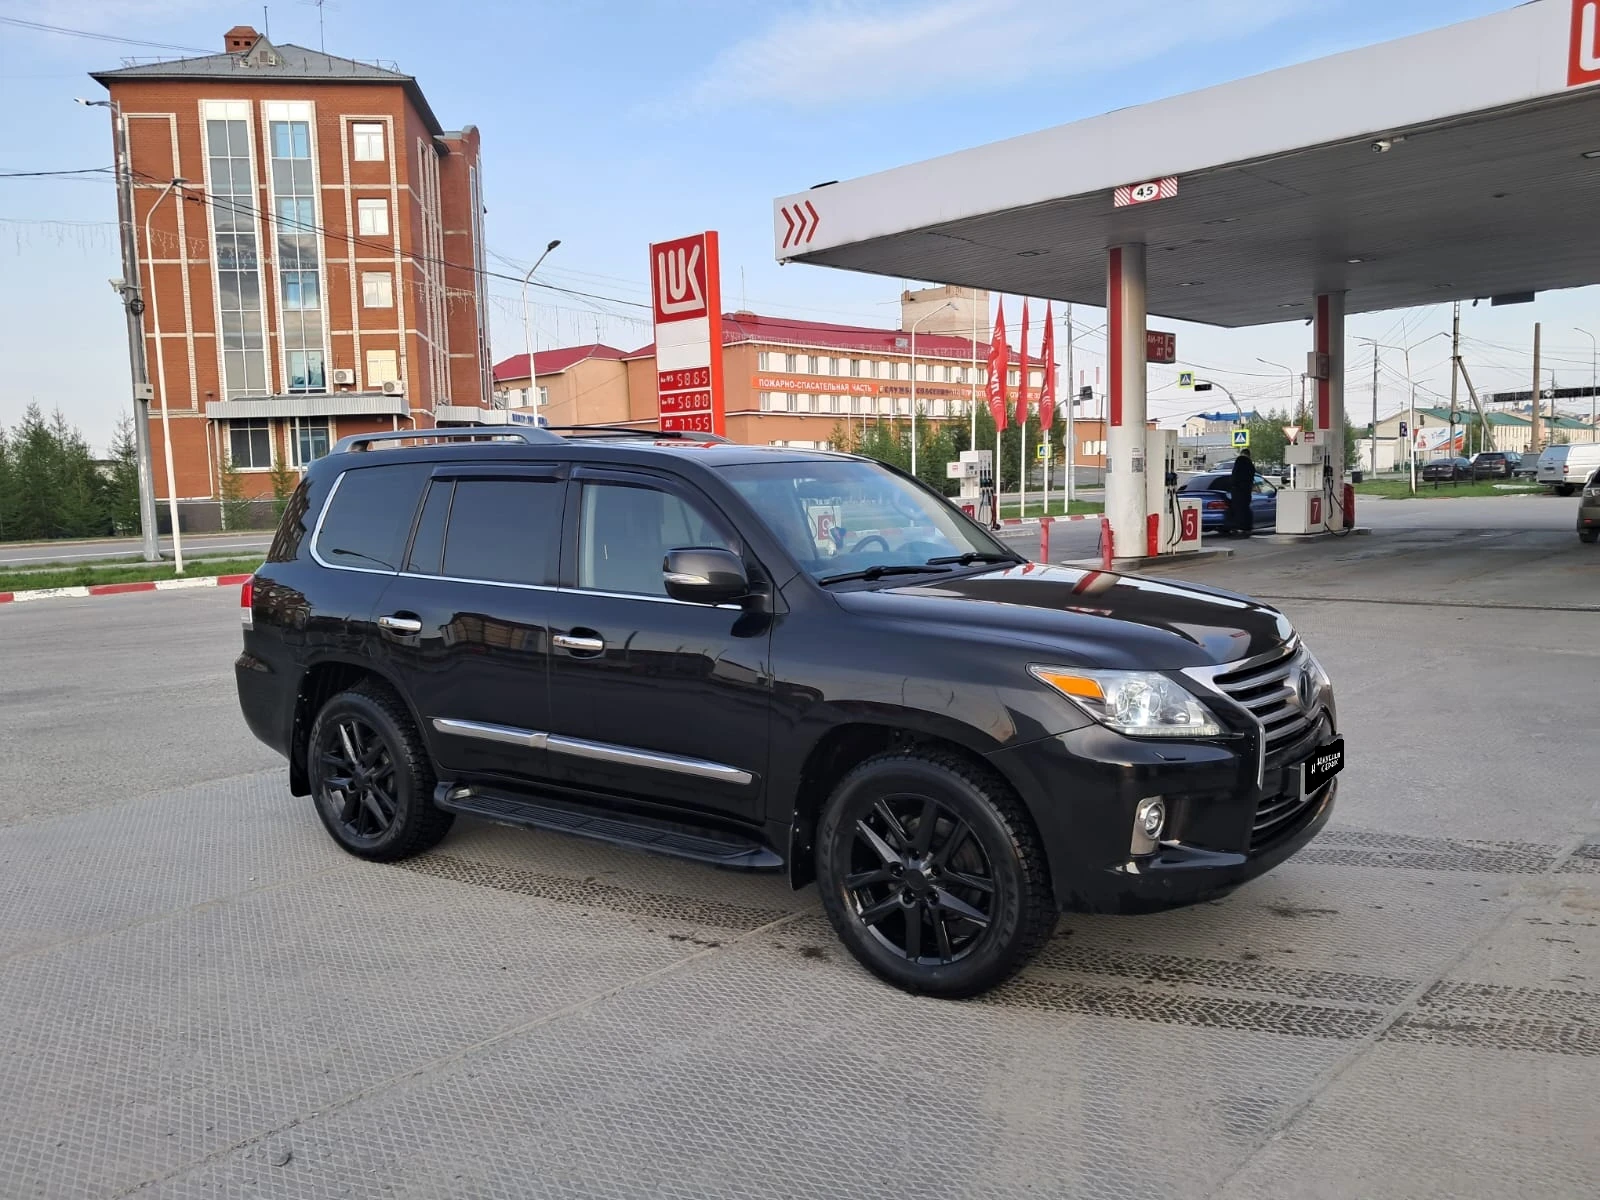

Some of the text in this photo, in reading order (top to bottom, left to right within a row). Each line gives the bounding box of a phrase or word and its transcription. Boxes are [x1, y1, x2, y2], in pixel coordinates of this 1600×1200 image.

[759, 379, 873, 393] ПОЖАРНО-СПАСАТЕЛЬНАЯ ЧАСТЬ
[1313, 501, 1319, 521] 7
[1185, 513, 1194, 536] 5
